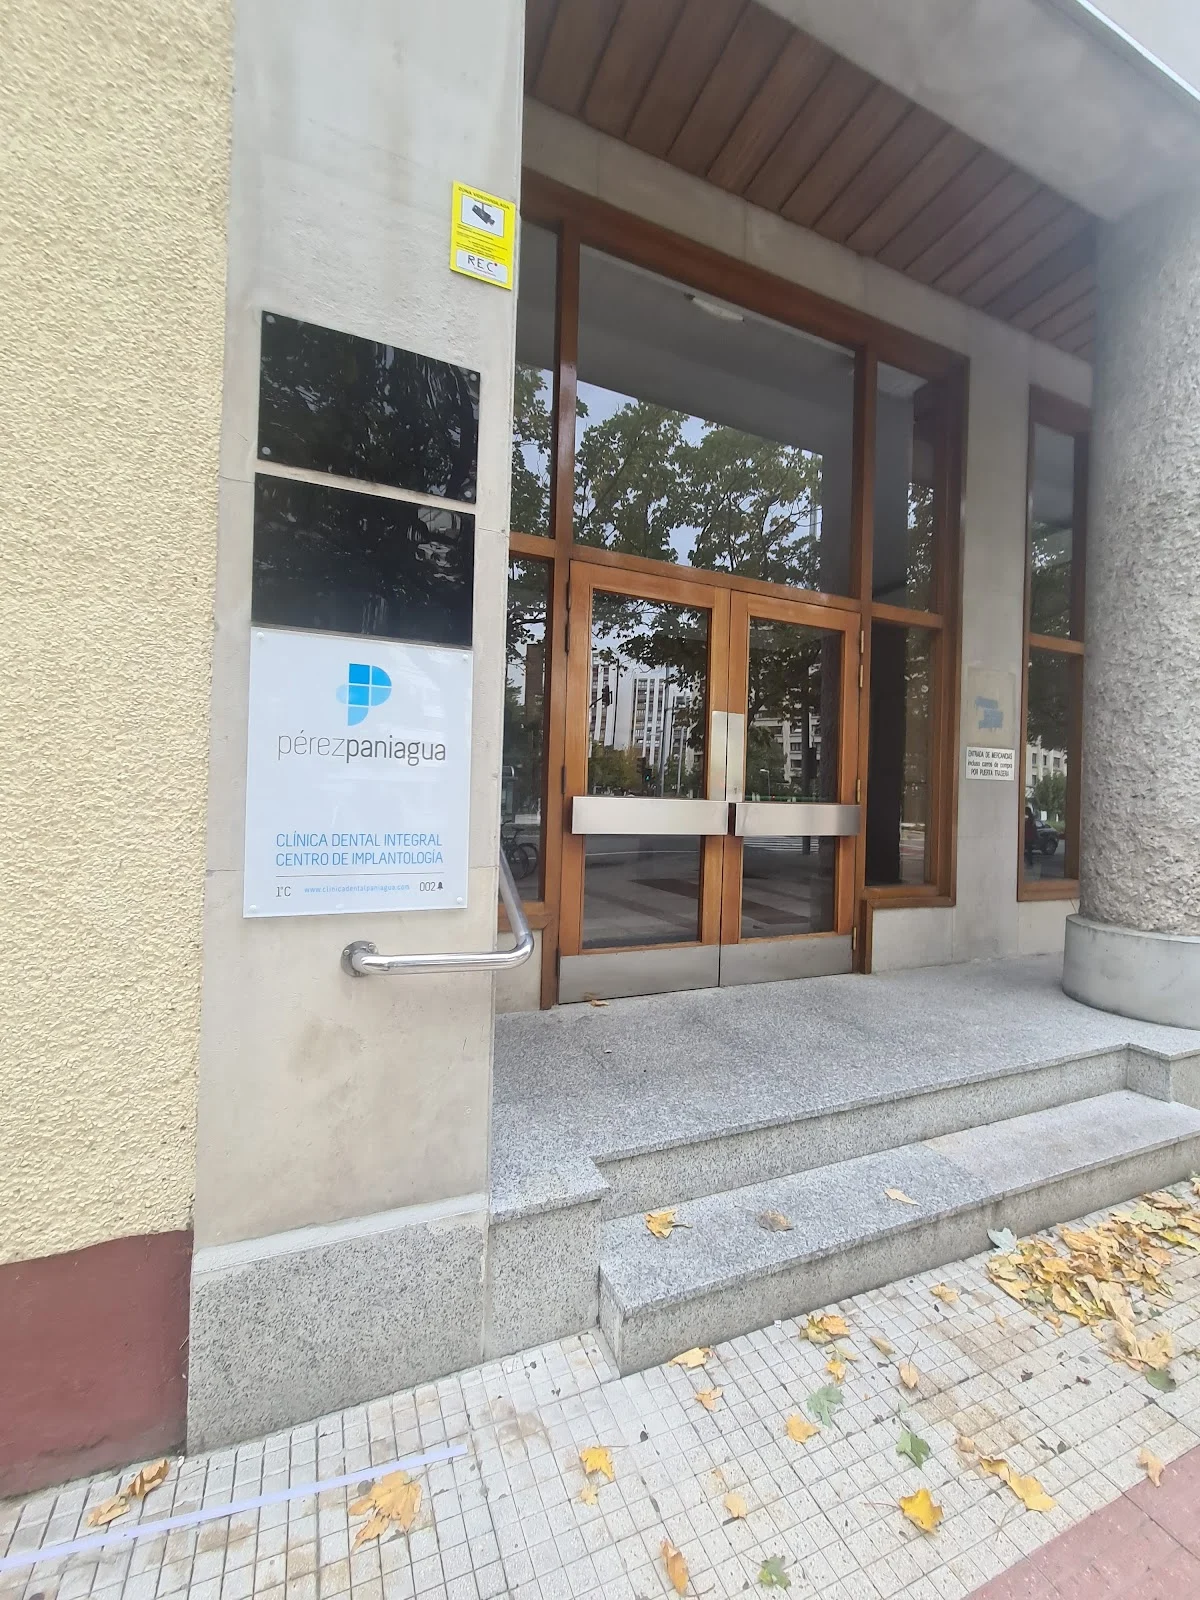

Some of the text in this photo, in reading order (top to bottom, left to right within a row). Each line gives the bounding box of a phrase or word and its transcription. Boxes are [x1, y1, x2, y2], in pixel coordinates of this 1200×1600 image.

[467, 254, 493, 272] REC
[277, 730, 446, 766] pérezpaniagua
[276, 831, 443, 847] CLÍNICA DENTAL INTEGRAL
[276, 849, 443, 867] CENTRO DE IMPLANTOLOGÍA
[304, 884, 409, 894] www.clinicadentalpaniagua.com
[419, 881, 436, 892] 002
